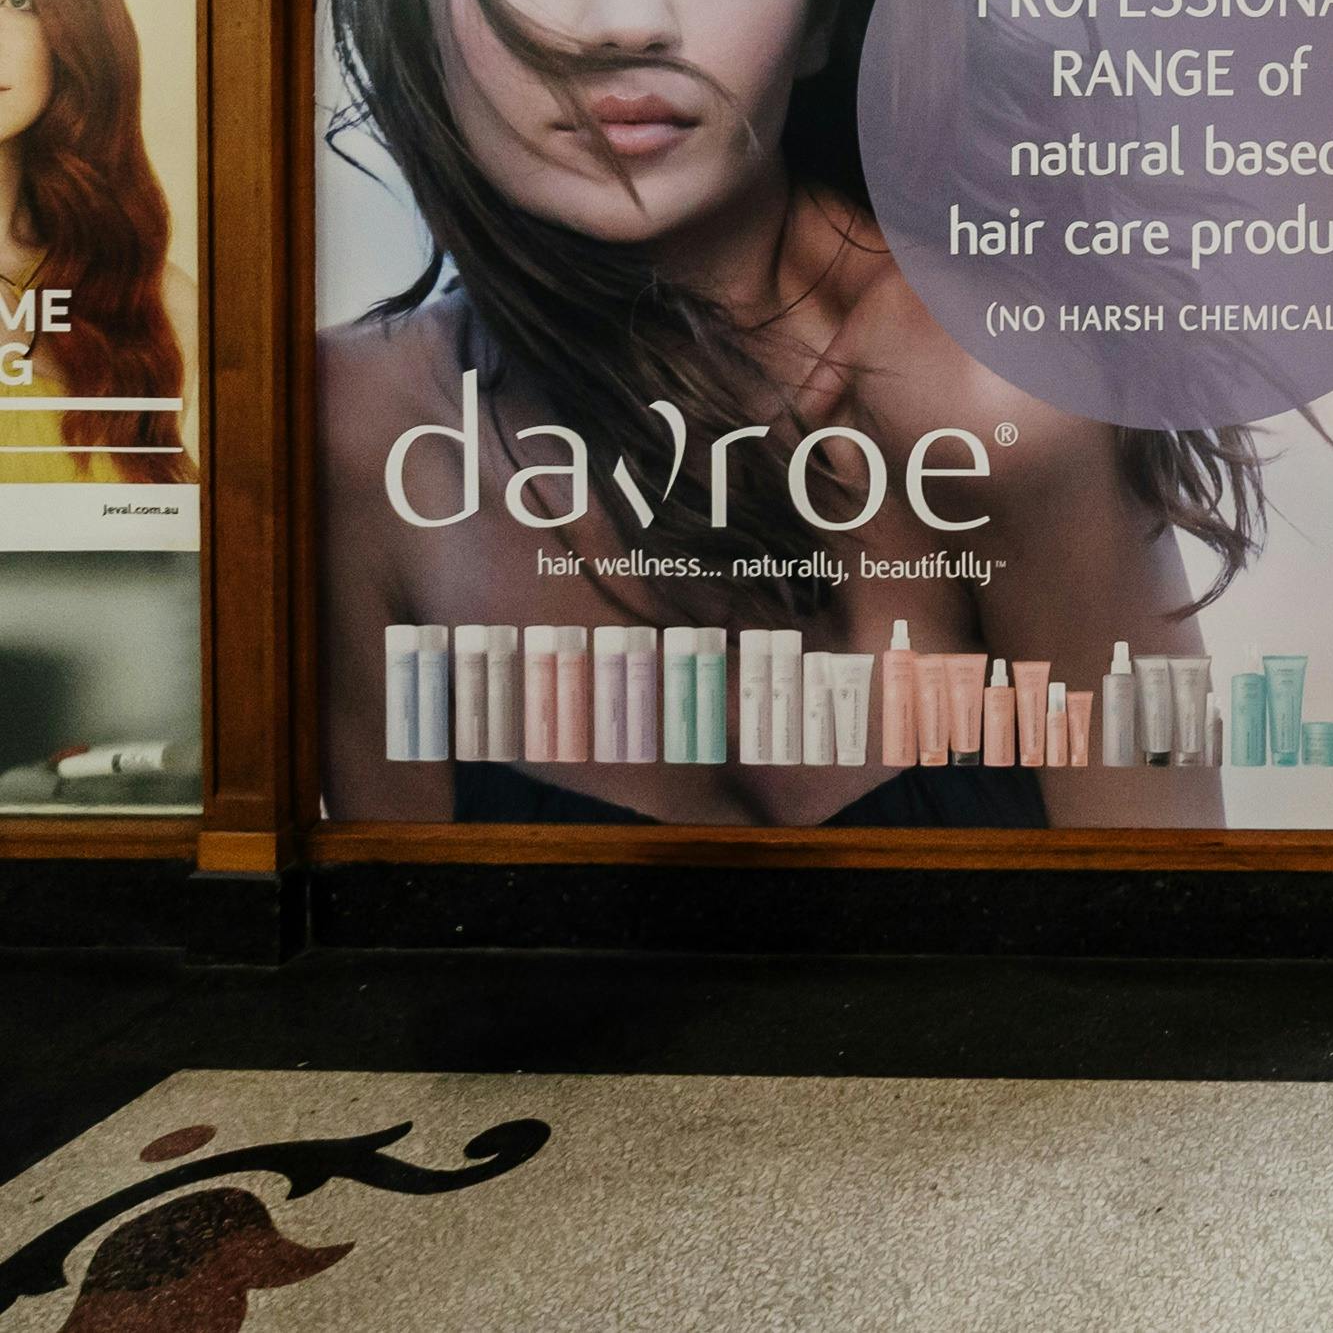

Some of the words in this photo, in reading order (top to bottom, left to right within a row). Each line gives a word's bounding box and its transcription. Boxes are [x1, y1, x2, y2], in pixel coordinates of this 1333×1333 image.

[1052, 48, 1235, 97] RANGE
[1258, 44, 1313, 97] of
[1010, 125, 1184, 176] natural
[950, 207, 1044, 255] hair
[1064, 218, 1170, 255] care
[986, 302, 1045, 337] (NO
[1059, 305, 1164, 333] HARSH
[0, 342, 33, 385] G
[537, 549, 584, 576] hair
[595, 549, 721, 577] wellness...
[733, 551, 849, 586] naturally,
